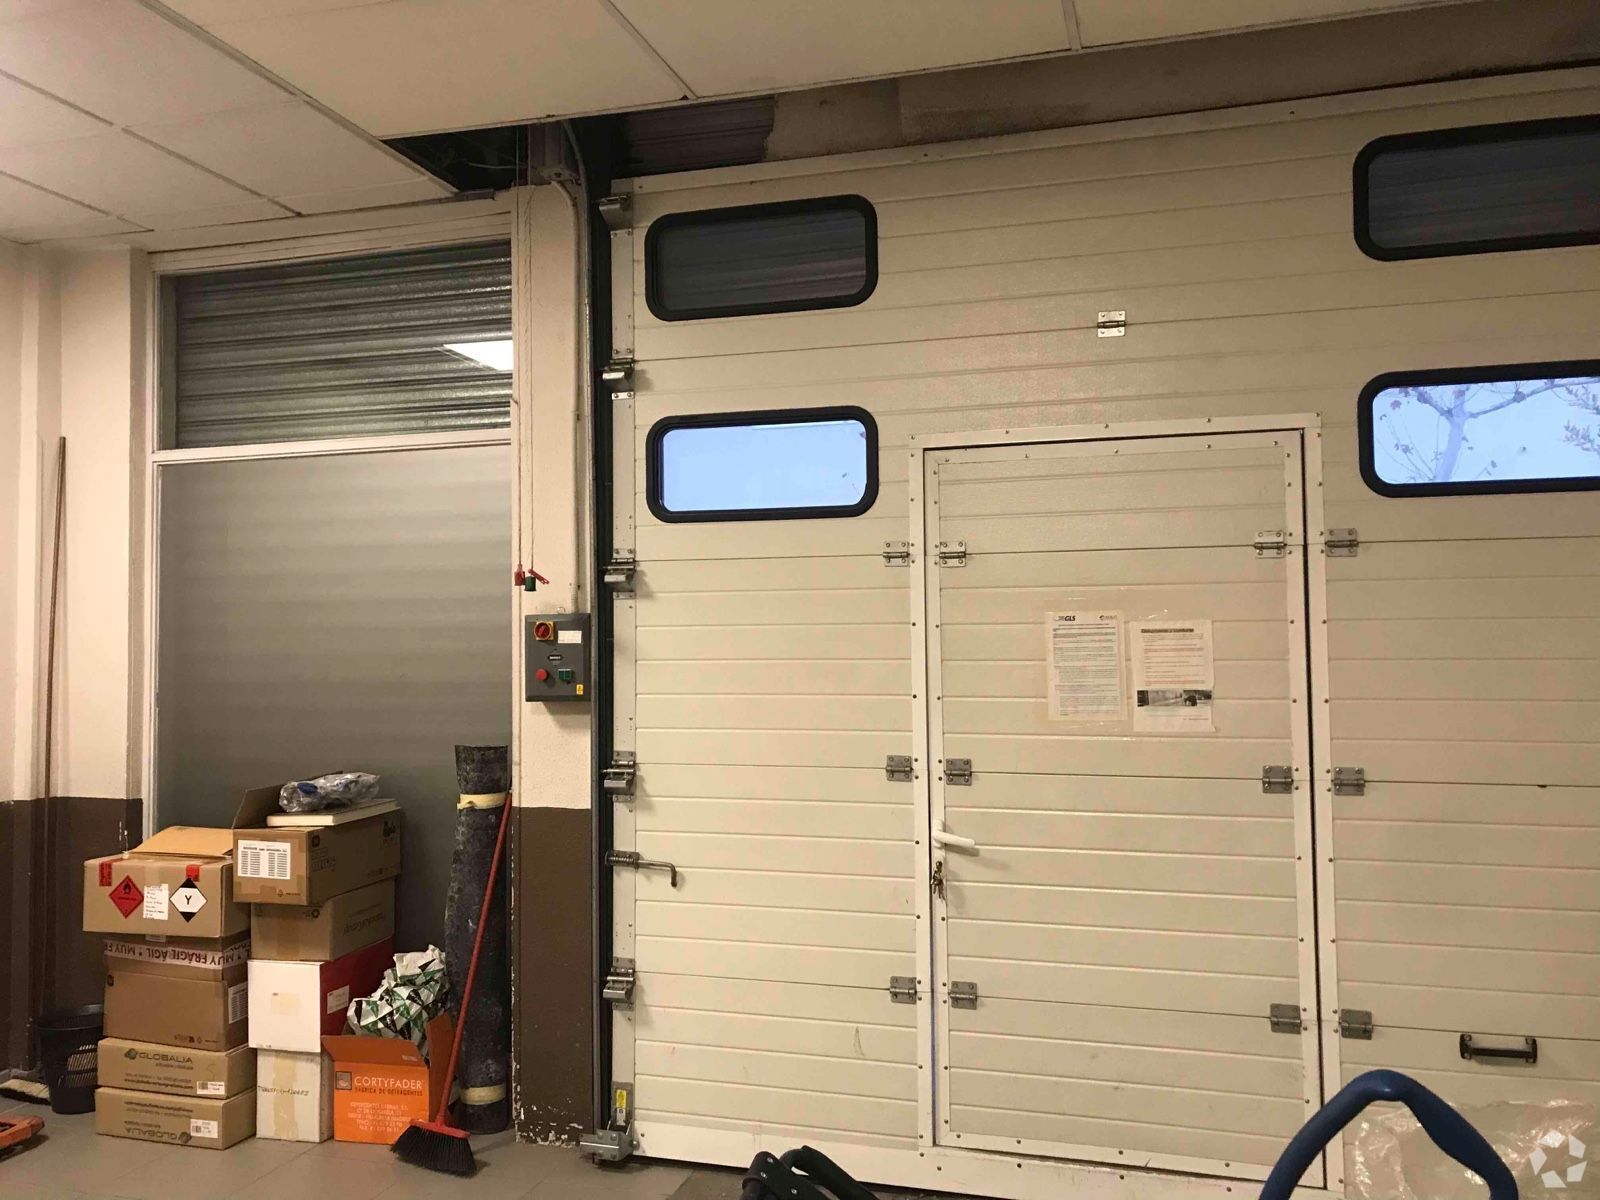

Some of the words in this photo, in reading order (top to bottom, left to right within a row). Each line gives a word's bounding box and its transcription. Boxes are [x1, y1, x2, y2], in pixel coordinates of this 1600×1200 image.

[185, 894, 192, 905] Y
[115, 943, 136, 956] MUY
[209, 953, 234, 966] MUY
[139, 1051, 193, 1063] GLOBALIA
[125, 1127, 177, 1140] GLOBALIA
